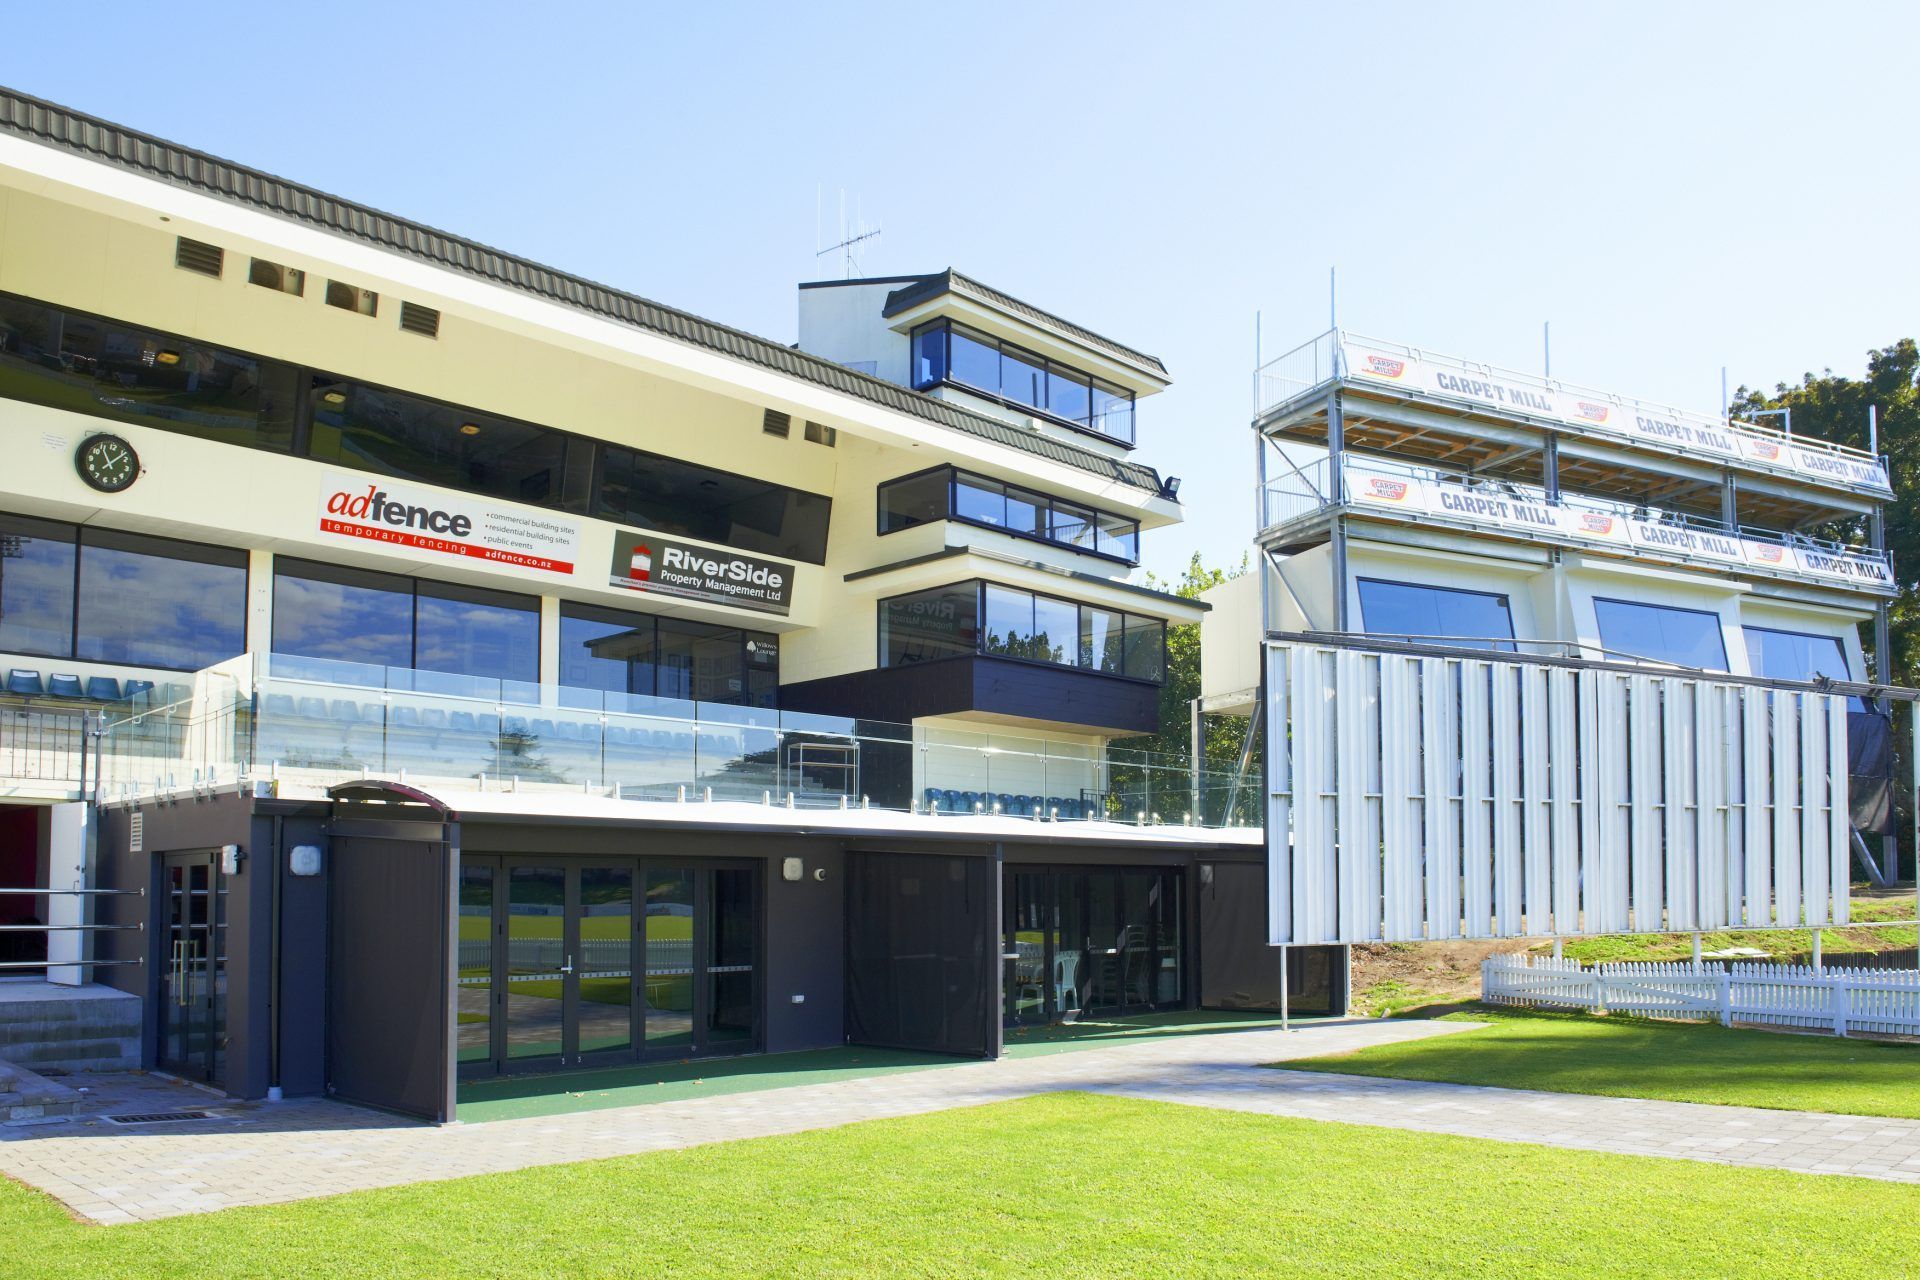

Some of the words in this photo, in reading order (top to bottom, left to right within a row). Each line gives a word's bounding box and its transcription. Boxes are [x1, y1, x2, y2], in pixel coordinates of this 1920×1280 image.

[1437, 372, 1504, 402] CARPET
[1508, 388, 1552, 412] MILL
[110, 443, 117, 451] 12
[1636, 416, 1693, 441] CARPET
[1695, 429, 1732, 451] MILL
[1802, 453, 1848, 477] CARPET
[1851, 465, 1882, 483] MILL
[327, 485, 472, 537] adfence
[1441, 491, 1508, 518] CARPET
[1513, 504, 1557, 526] MILL
[327, 521, 404, 544] temporary
[413, 535, 467, 554] fencing
[489, 524, 525, 537] residential
[526, 531, 554, 543] building
[555, 536, 570, 545] sites
[490, 513, 530, 525] commercial
[531, 520, 559, 532] building
[560, 526, 575, 535] sites
[487, 535, 509, 546] public
[510, 541, 533, 549] events
[1640, 525, 1697, 549] CARPET
[1701, 537, 1737, 556] MILL
[485, 551, 552, 568] adfence.co.nz
[663, 547, 783, 588] RiverSide
[1805, 553, 1853, 575] CARPET
[1855, 562, 1887, 581] MILL
[660, 569, 702, 589] Property
[705, 578, 764, 598] Management
[766, 589, 782, 601] Ltd
[757, 641, 777, 650] Willows
